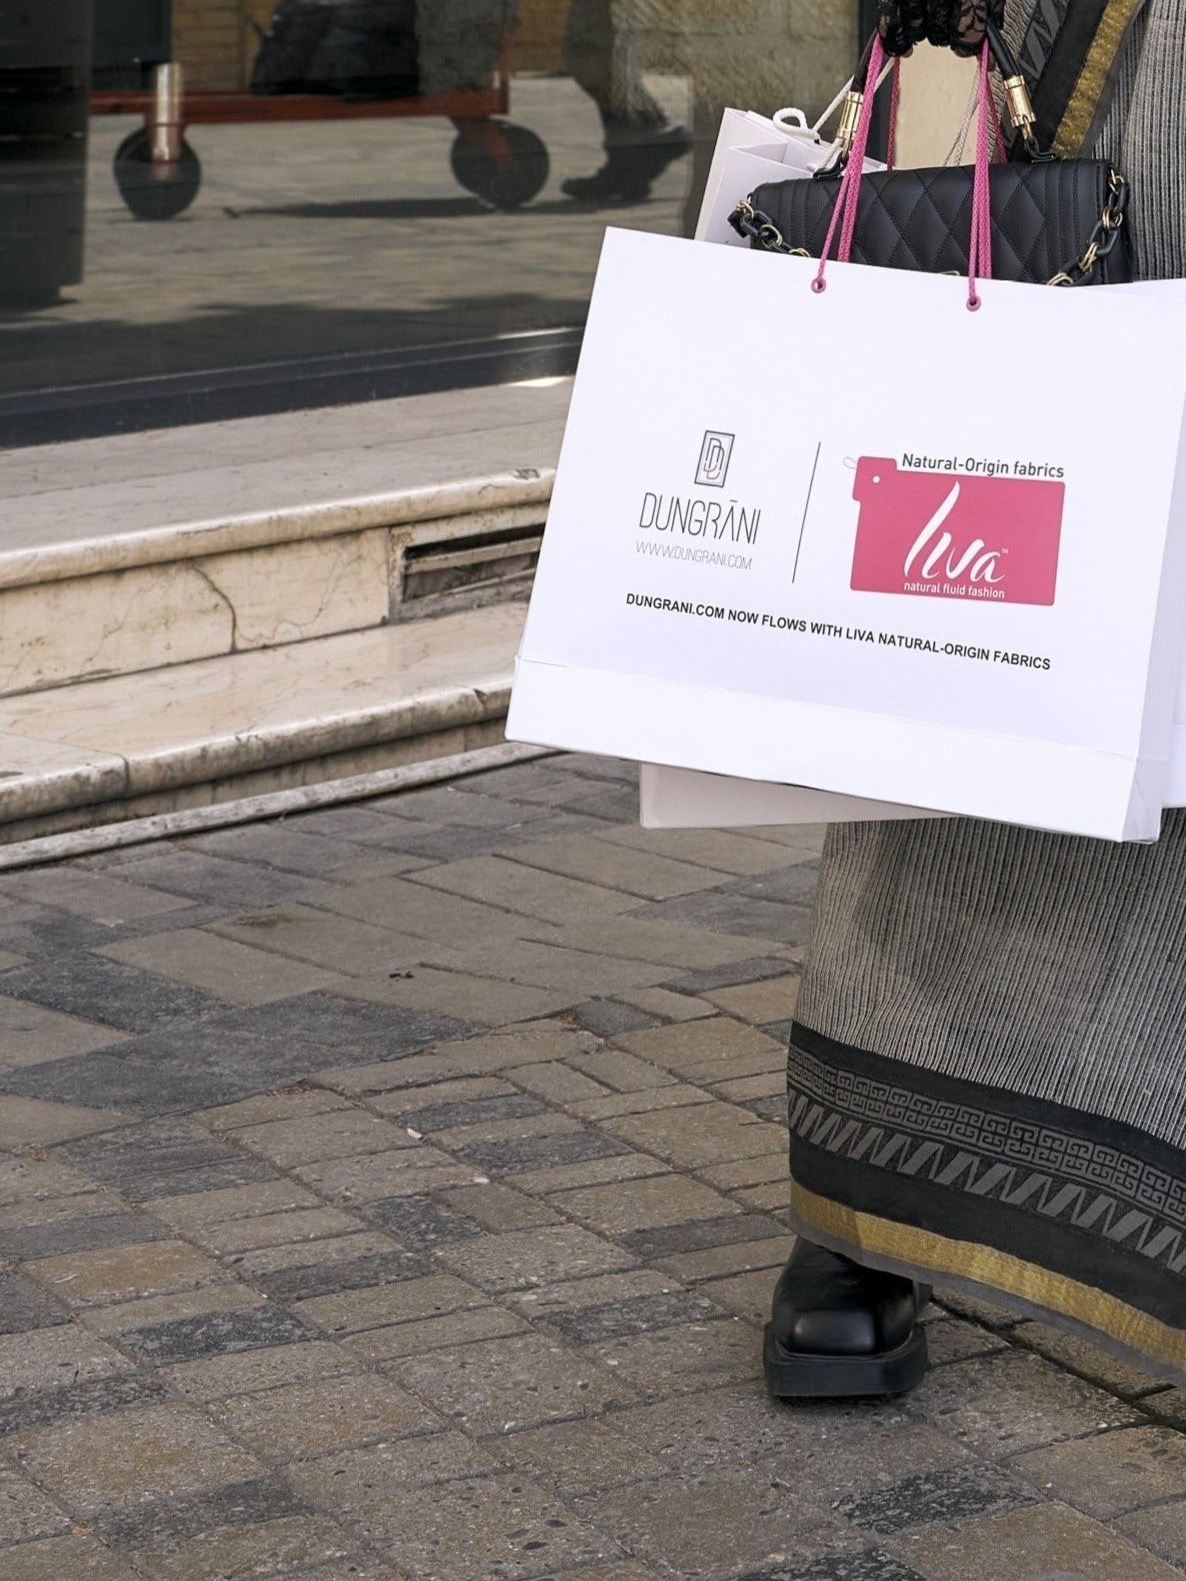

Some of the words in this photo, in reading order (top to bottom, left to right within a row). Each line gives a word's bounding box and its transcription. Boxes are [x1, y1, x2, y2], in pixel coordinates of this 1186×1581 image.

[902, 453, 1009, 477] Natural-Origin
[1013, 460, 1064, 478] fabrics
[636, 540, 752, 570] WWW.DUNGRANI.COM
[904, 582, 941, 594] natural
[943, 583, 966, 596] fluid
[968, 585, 1005, 599] fashion
[626, 593, 725, 619] DUNGRANI.COM
[728, 609, 759, 624] NOW
[762, 614, 807, 632] FLOWS
[810, 621, 843, 638] WITH
[846, 627, 874, 643] LIVA
[878, 632, 990, 661] NATURAL-ORIGIN
[993, 650, 1051, 671] FABRICS
